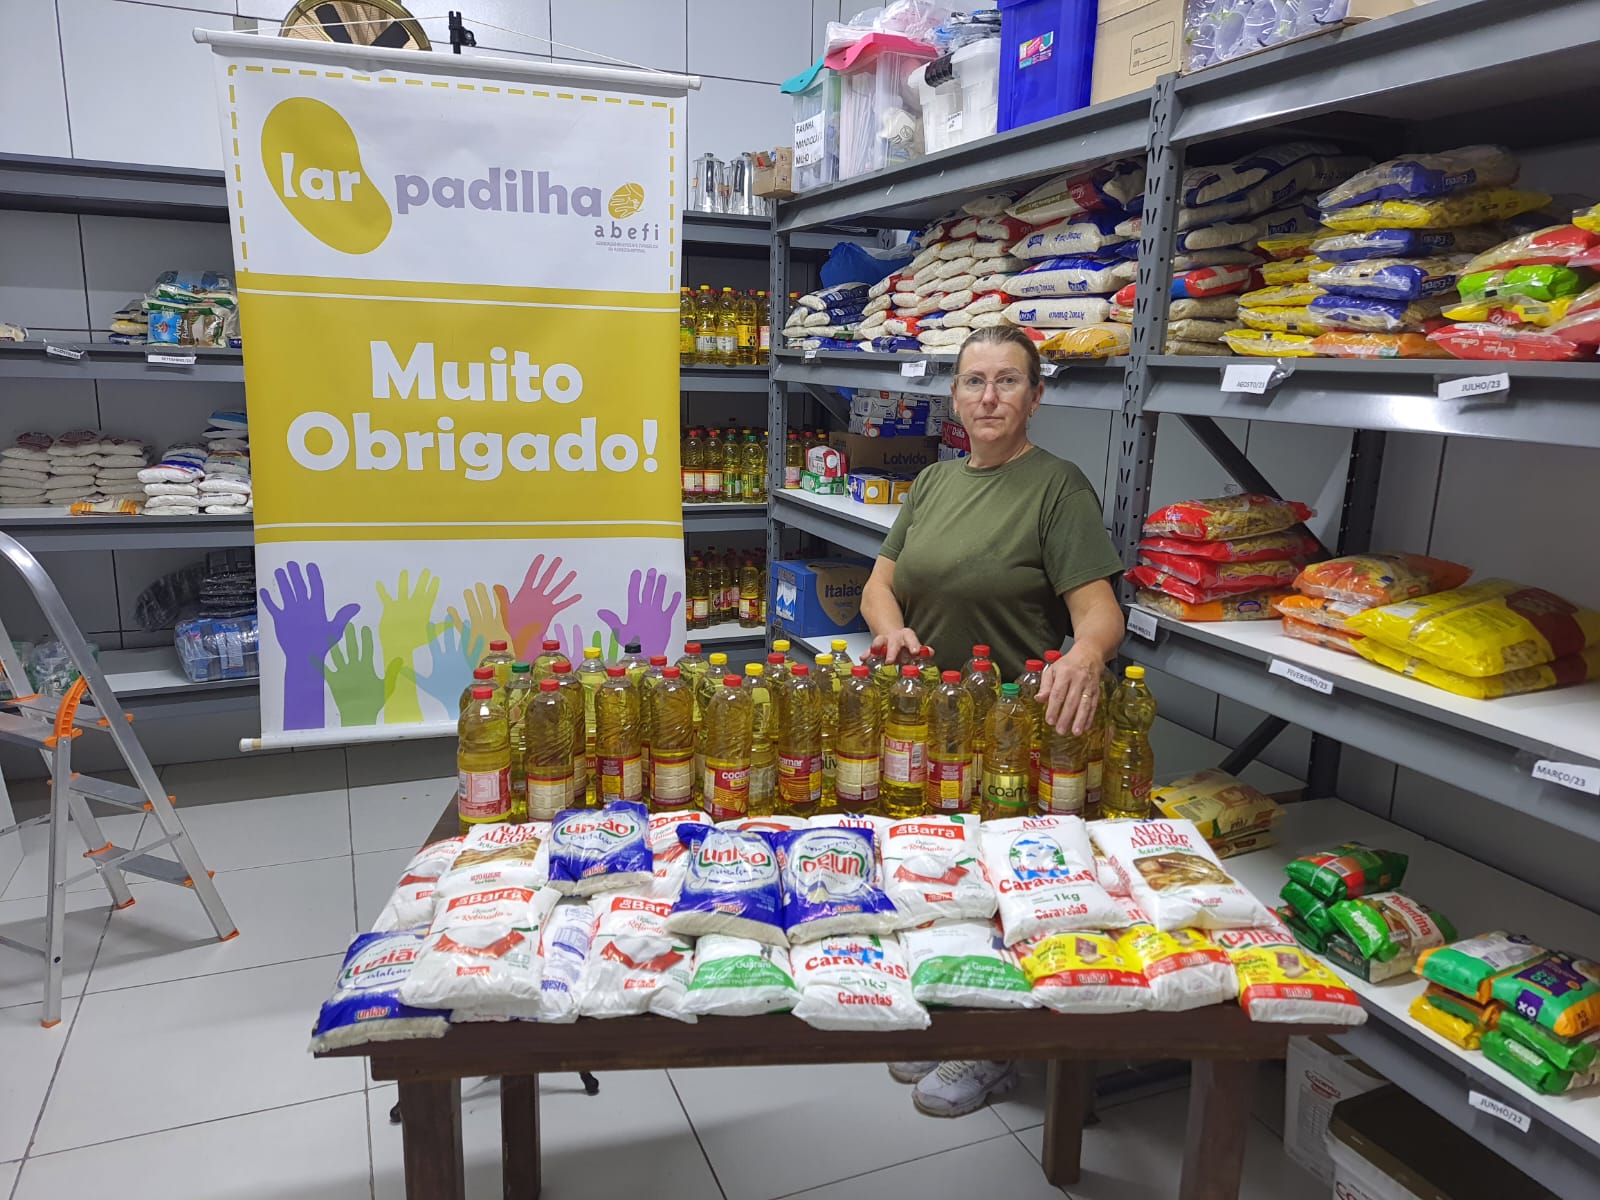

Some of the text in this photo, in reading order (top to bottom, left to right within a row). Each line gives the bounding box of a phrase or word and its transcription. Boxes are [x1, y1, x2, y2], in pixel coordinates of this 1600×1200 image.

[281, 152, 602, 218] lar padilha
[594, 221, 659, 241] abefi
[370, 340, 583, 403] Muito
[1461, 380, 1501, 392] JULHO/23
[286, 410, 658, 481] Obrigado!
[1535, 765, 1586, 787] MARÇO/23
[988, 783, 1026, 798] coam
[1133, 823, 1175, 836] ALTO
[1130, 834, 1190, 849] ALEGRE
[632, 900, 672, 916] Barr
[1386, 894, 1432, 936] Polentina
[838, 991, 892, 1006] Caravelas
[1480, 1099, 1523, 1124] JUNHO/22
